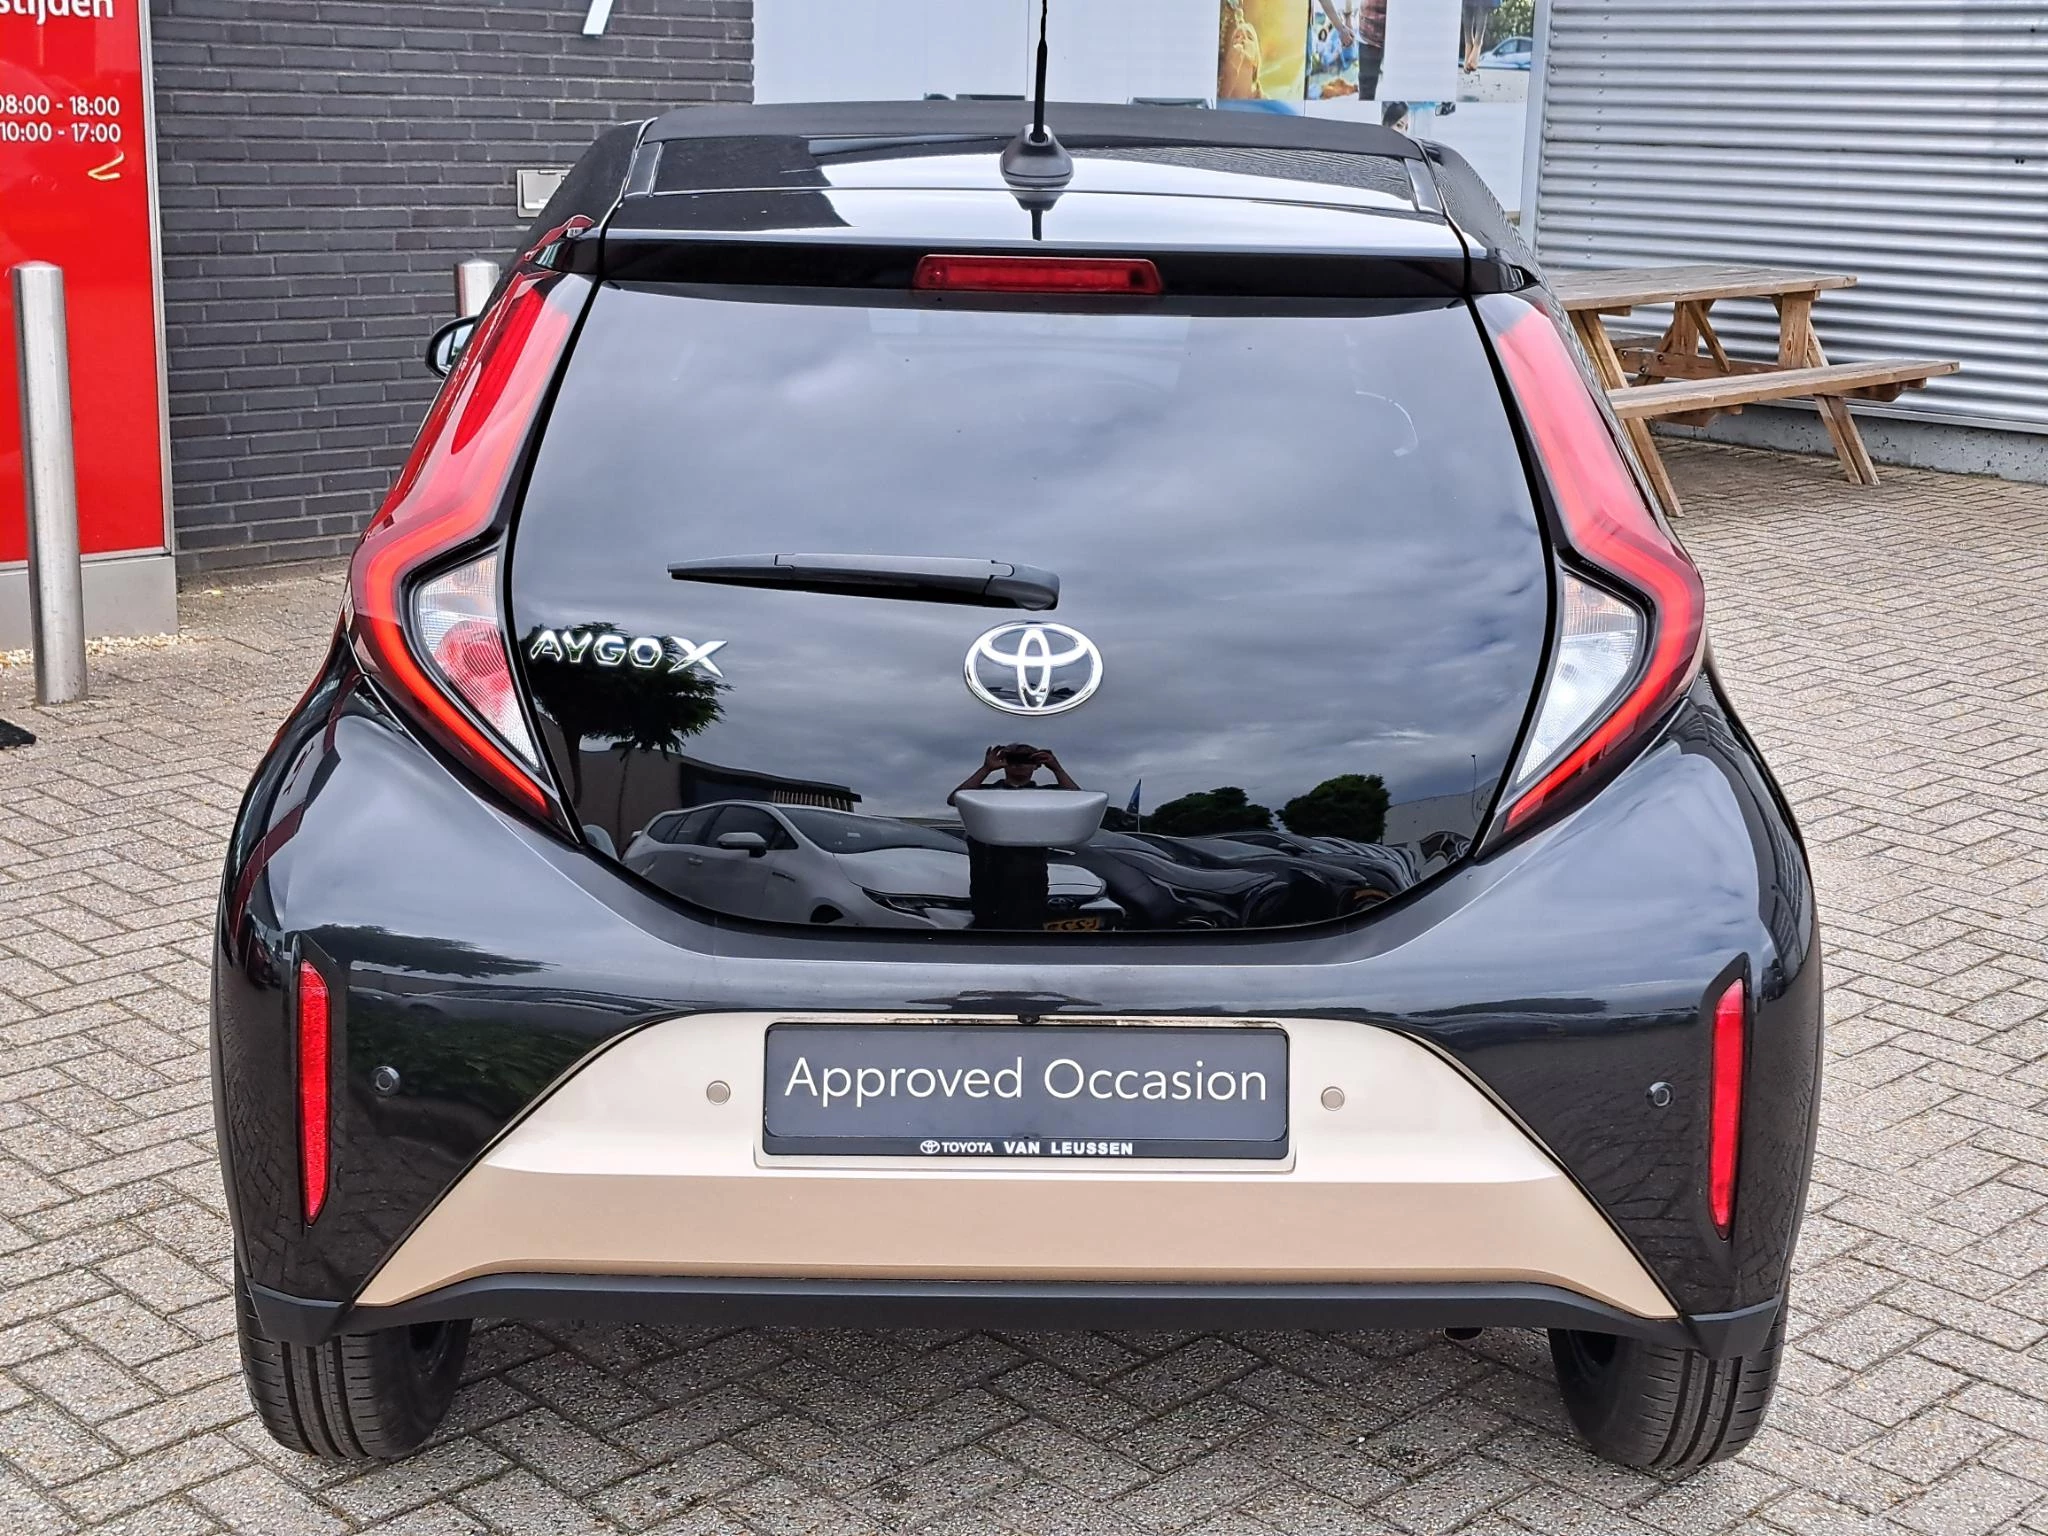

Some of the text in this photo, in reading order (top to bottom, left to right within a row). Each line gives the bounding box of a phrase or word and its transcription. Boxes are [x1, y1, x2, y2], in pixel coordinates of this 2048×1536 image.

[69, 95, 120, 117] 18:00
[0, 121, 52, 142] 10:00
[71, 122, 121, 143] 17:00
[784, 1056, 1267, 1108] Approved Occasion
[941, 1141, 1133, 1155] TOYOTA VAN LEUSSEN
